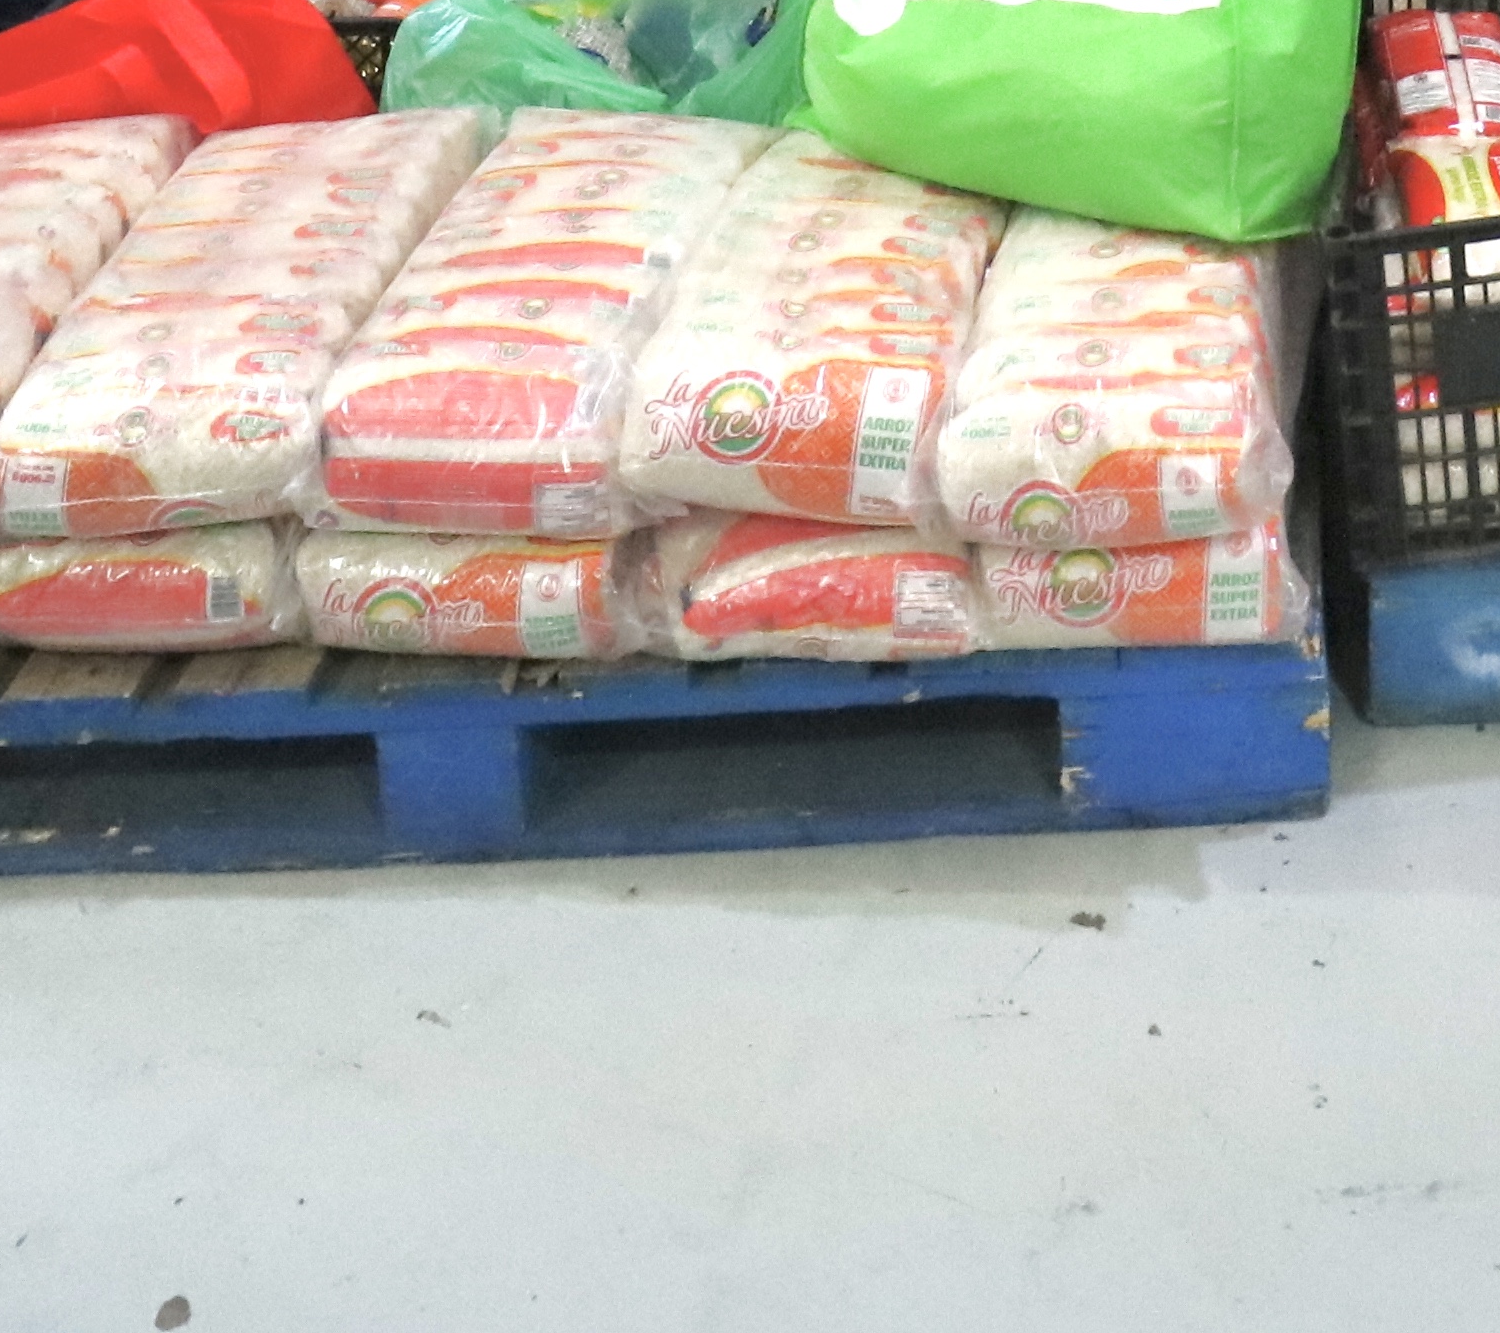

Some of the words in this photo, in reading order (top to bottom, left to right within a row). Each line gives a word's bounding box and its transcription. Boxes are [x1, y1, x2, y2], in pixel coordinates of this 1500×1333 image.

[645, 370, 692, 414] La
[649, 391, 829, 460] Nuestra
[862, 416, 916, 433] ARROZ
